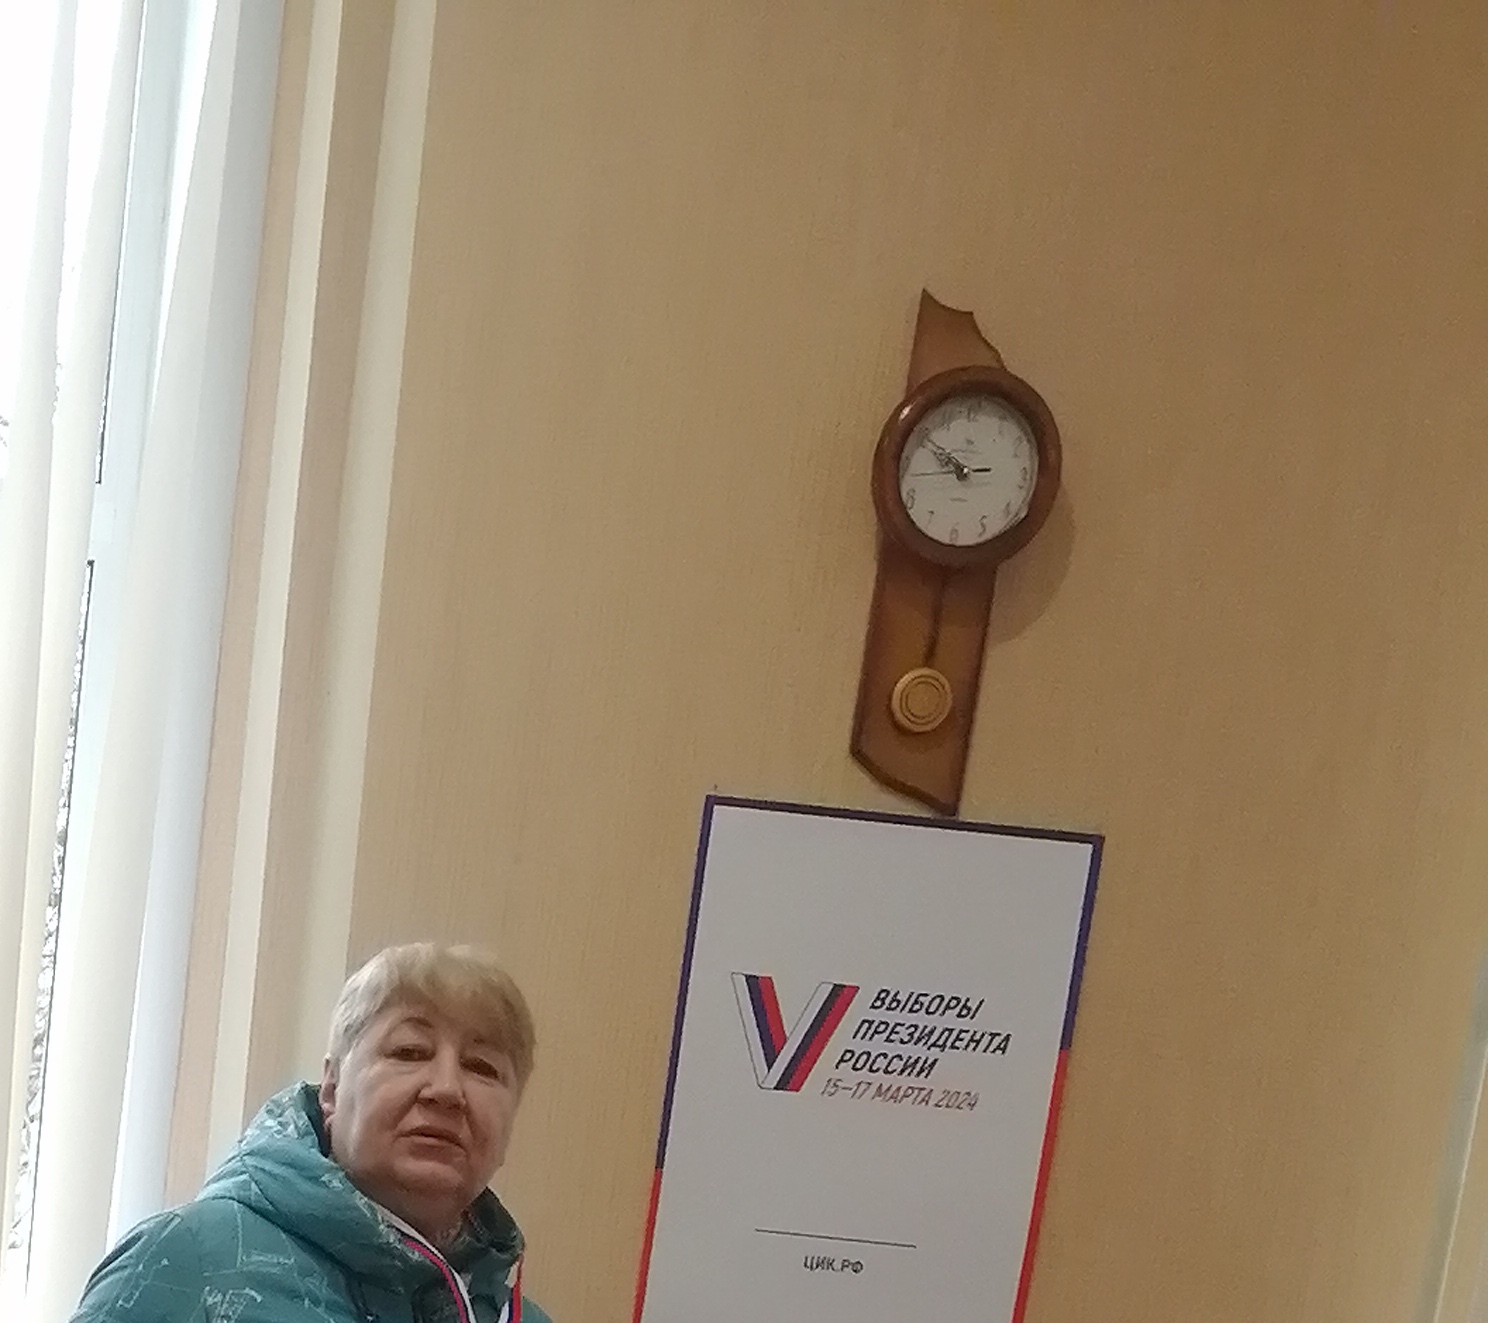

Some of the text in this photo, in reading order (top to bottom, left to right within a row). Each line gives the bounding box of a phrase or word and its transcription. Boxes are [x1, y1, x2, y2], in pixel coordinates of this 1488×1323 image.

[869, 988, 985, 1021] ВЫБОРЫ
[852, 1018, 1013, 1055] ПРЕЗИДЕНТА
[834, 1048, 940, 1080] РОССИИ
[871, 1082, 934, 1107] МАРТА
[933, 1088, 980, 1112] 2024
